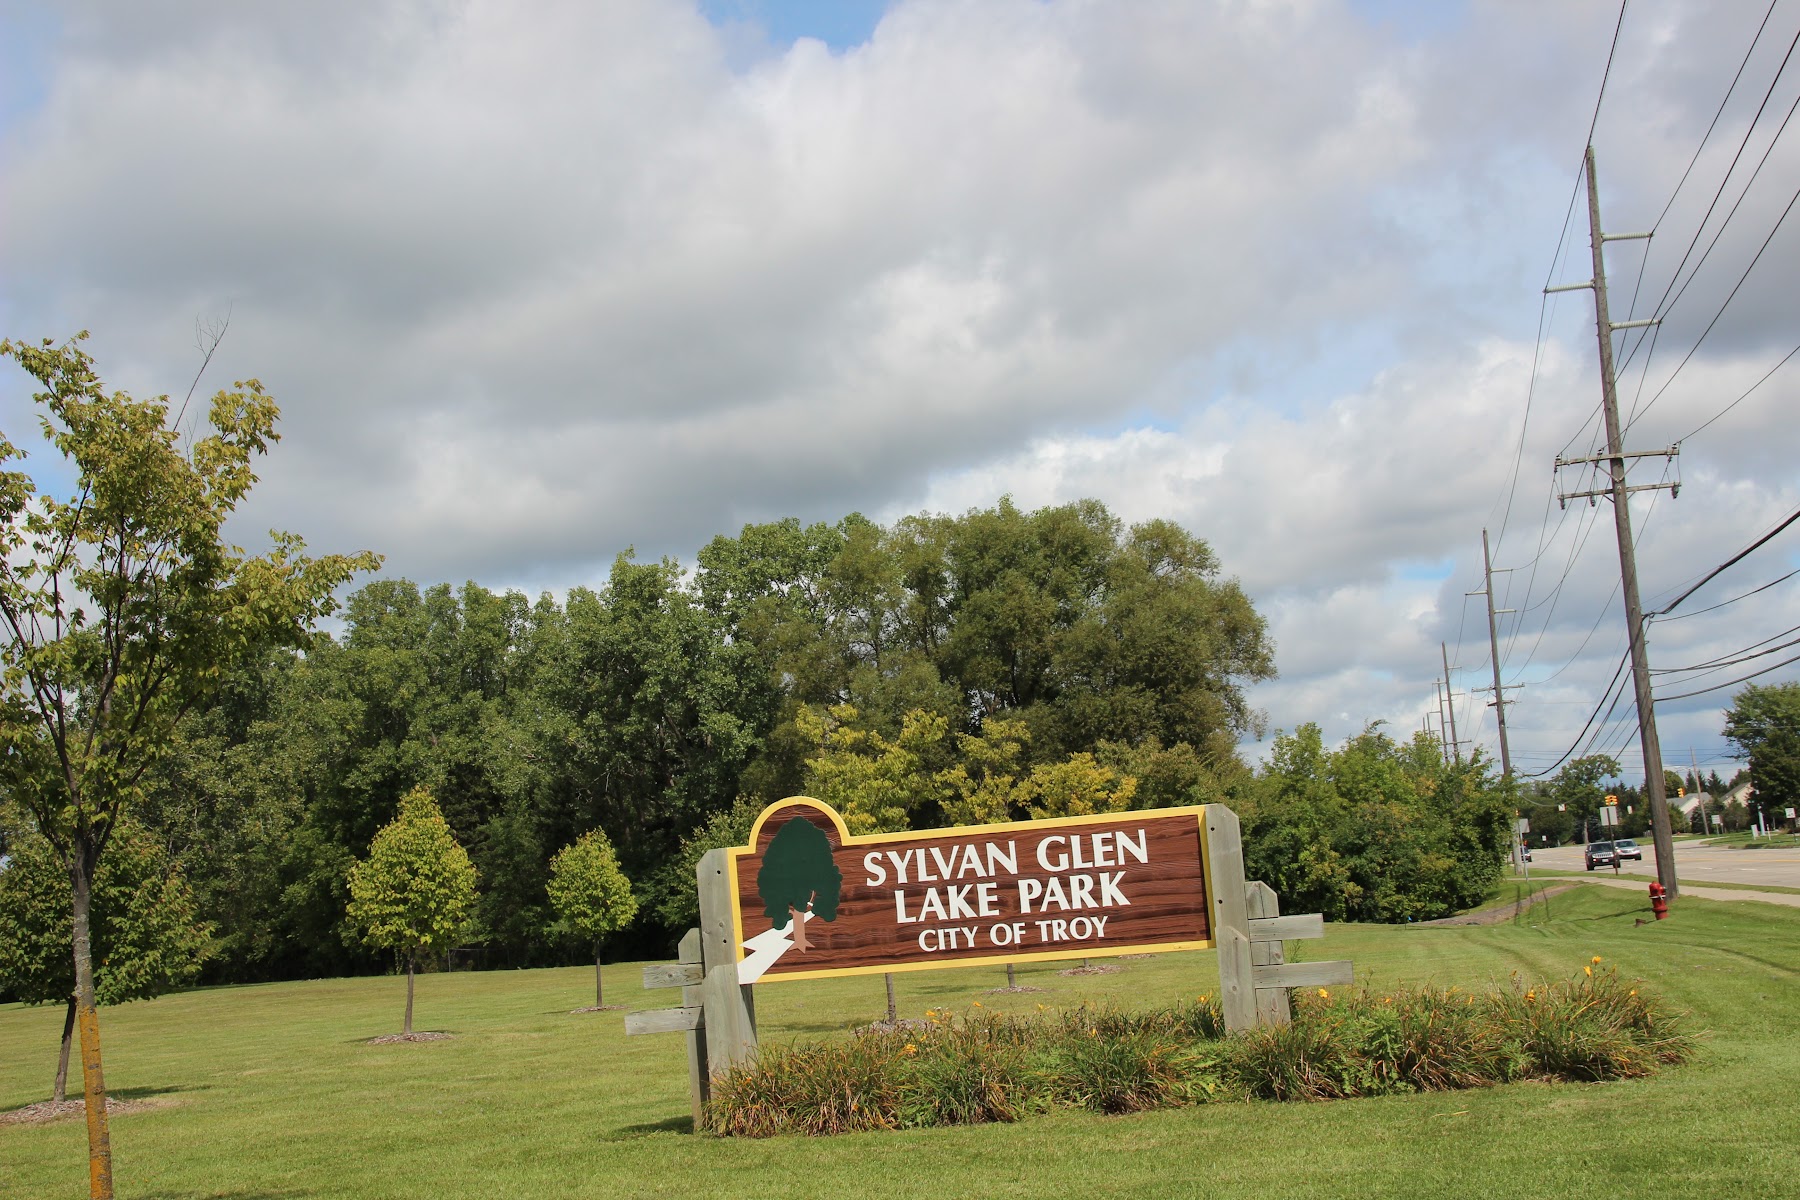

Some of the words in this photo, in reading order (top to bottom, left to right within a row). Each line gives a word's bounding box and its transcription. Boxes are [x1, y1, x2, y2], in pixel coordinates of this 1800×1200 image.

[863, 840, 1018, 887] SYLVAN
[1036, 828, 1149, 872] GLEN
[895, 881, 1000, 924] LAKE
[1018, 870, 1131, 914] PARK
[918, 925, 979, 952] CITY
[989, 922, 1026, 946] OF
[1034, 915, 1109, 942] TROY
